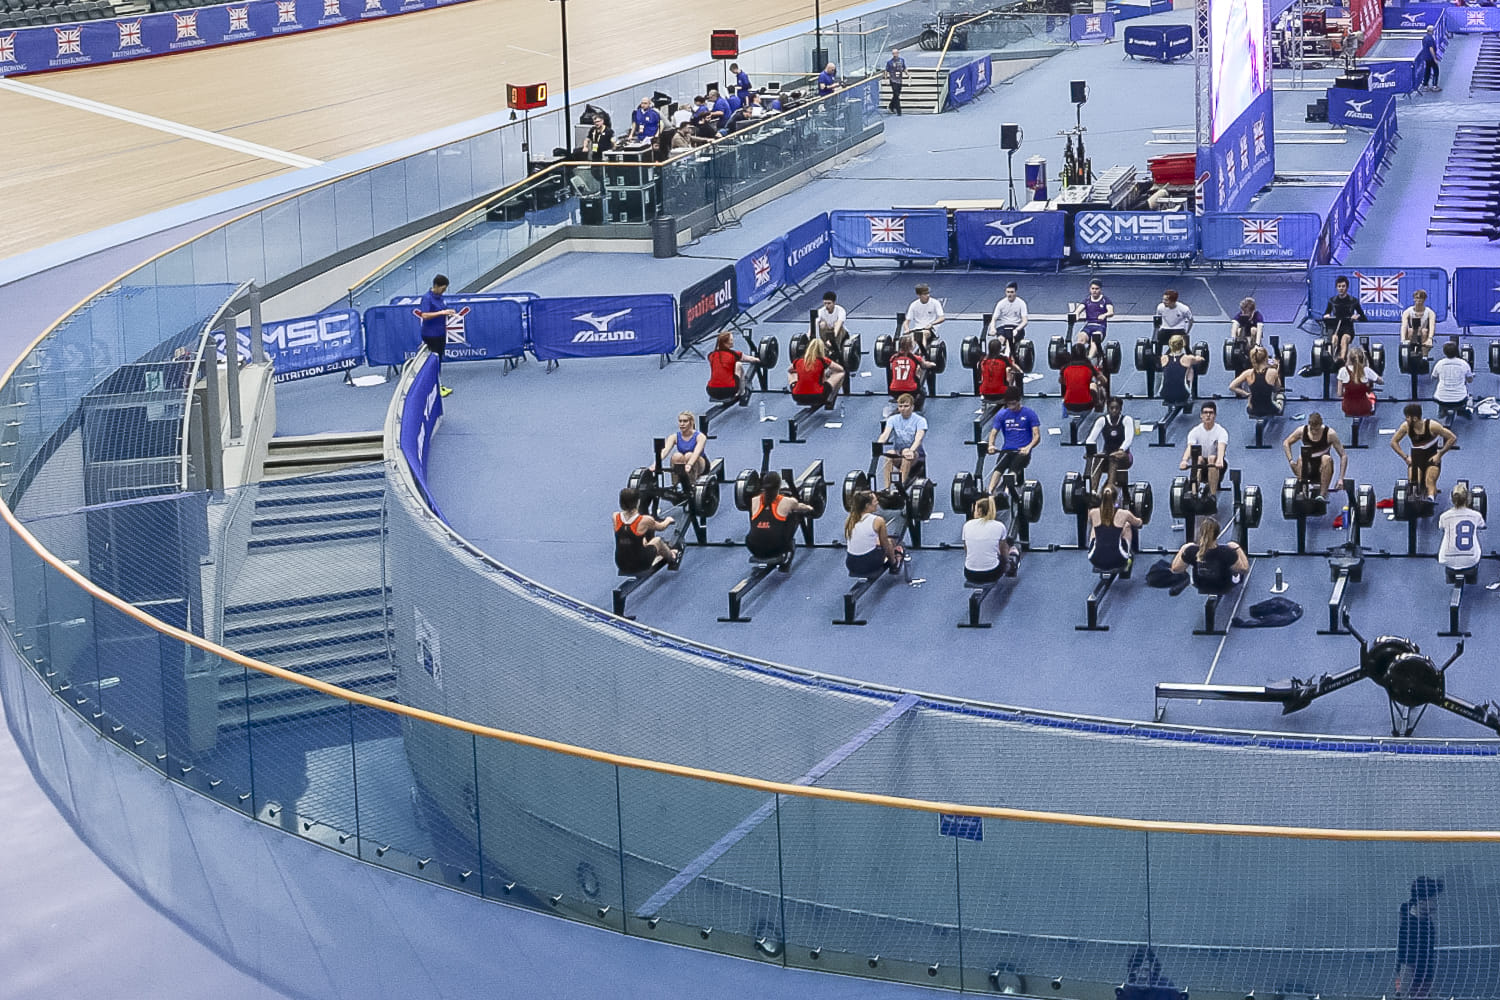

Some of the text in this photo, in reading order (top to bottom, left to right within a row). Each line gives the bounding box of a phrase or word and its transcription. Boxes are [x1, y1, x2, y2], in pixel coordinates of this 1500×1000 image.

[1114, 214, 1188, 234] MSC
[262, 314, 350, 349] MSC
[444, 348, 487, 358] ROWING
[894, 364, 911, 380] 17
[1455, 519, 1476, 551] 8
